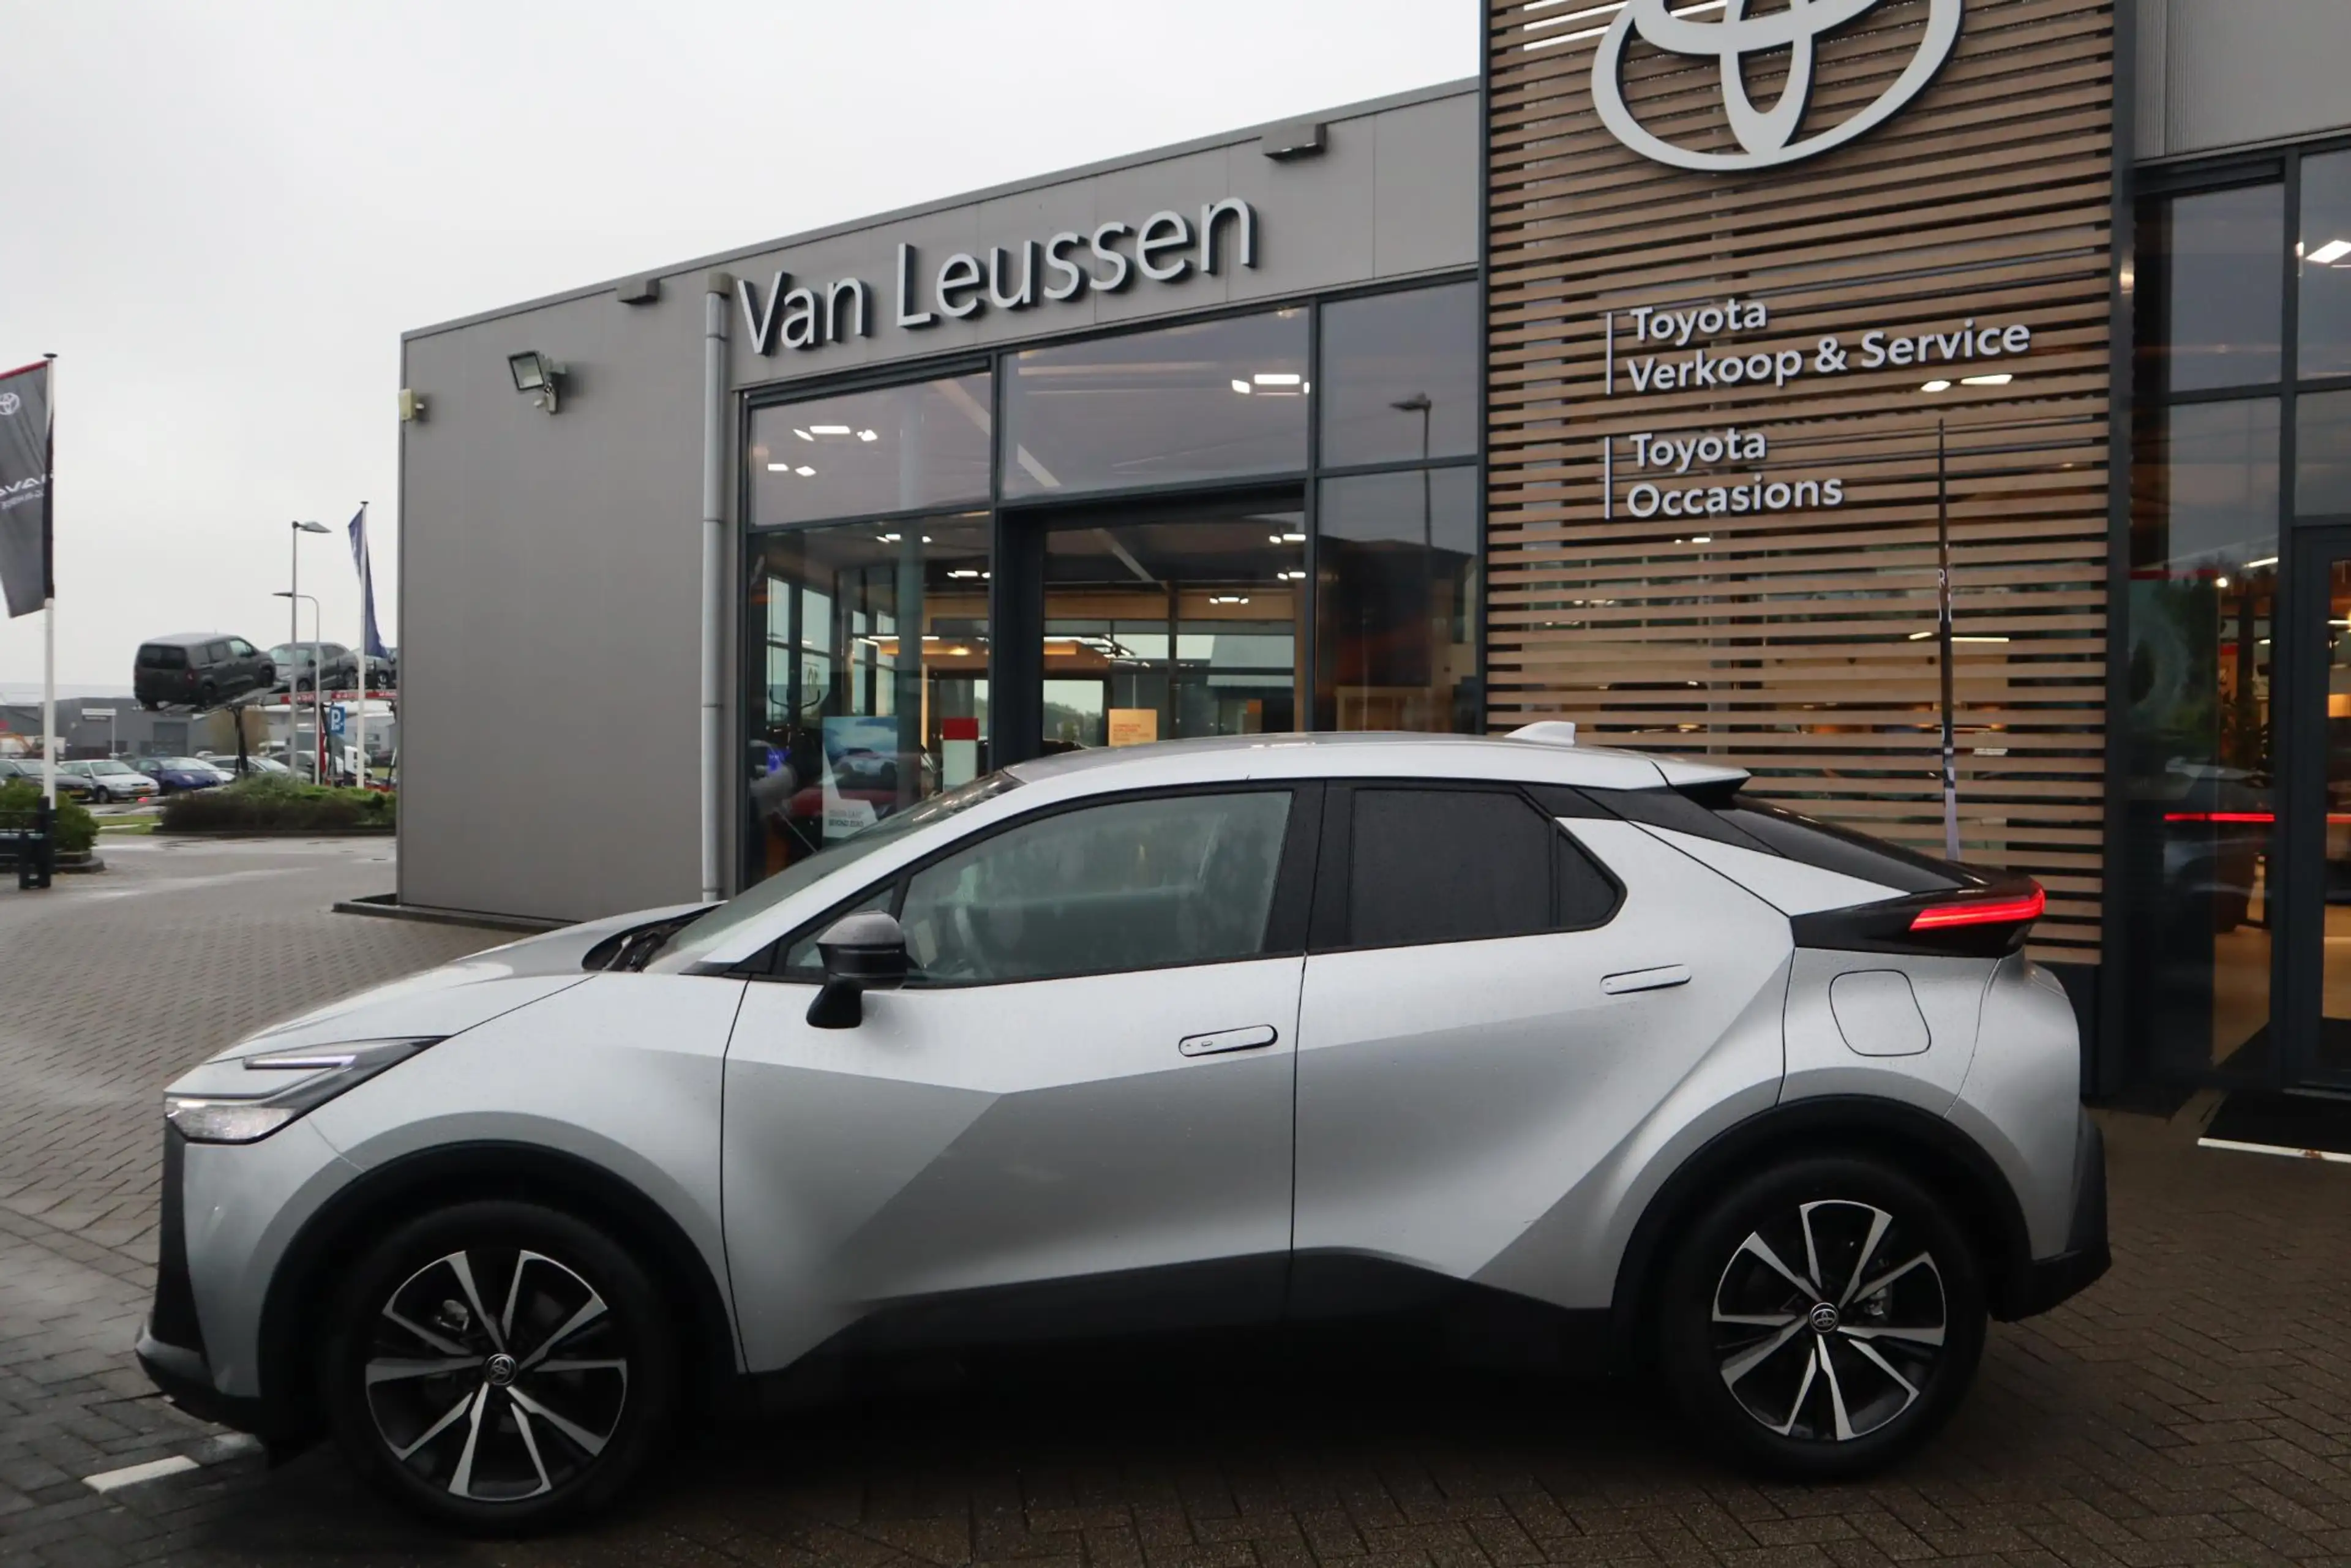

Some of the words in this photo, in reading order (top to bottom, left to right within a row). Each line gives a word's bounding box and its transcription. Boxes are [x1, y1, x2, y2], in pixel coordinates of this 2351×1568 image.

[738, 271, 869, 355] Van
[897, 197, 1258, 329] Leussen
[1630, 298, 1768, 347] Toyota
[1627, 347, 1802, 392] Verkoop
[1814, 336, 1848, 373] &
[1861, 318, 2032, 368] Service
[1630, 427, 1768, 473] Toyota
[1626, 473, 1844, 518] Occasions
[331, 709, 340, 730] P
